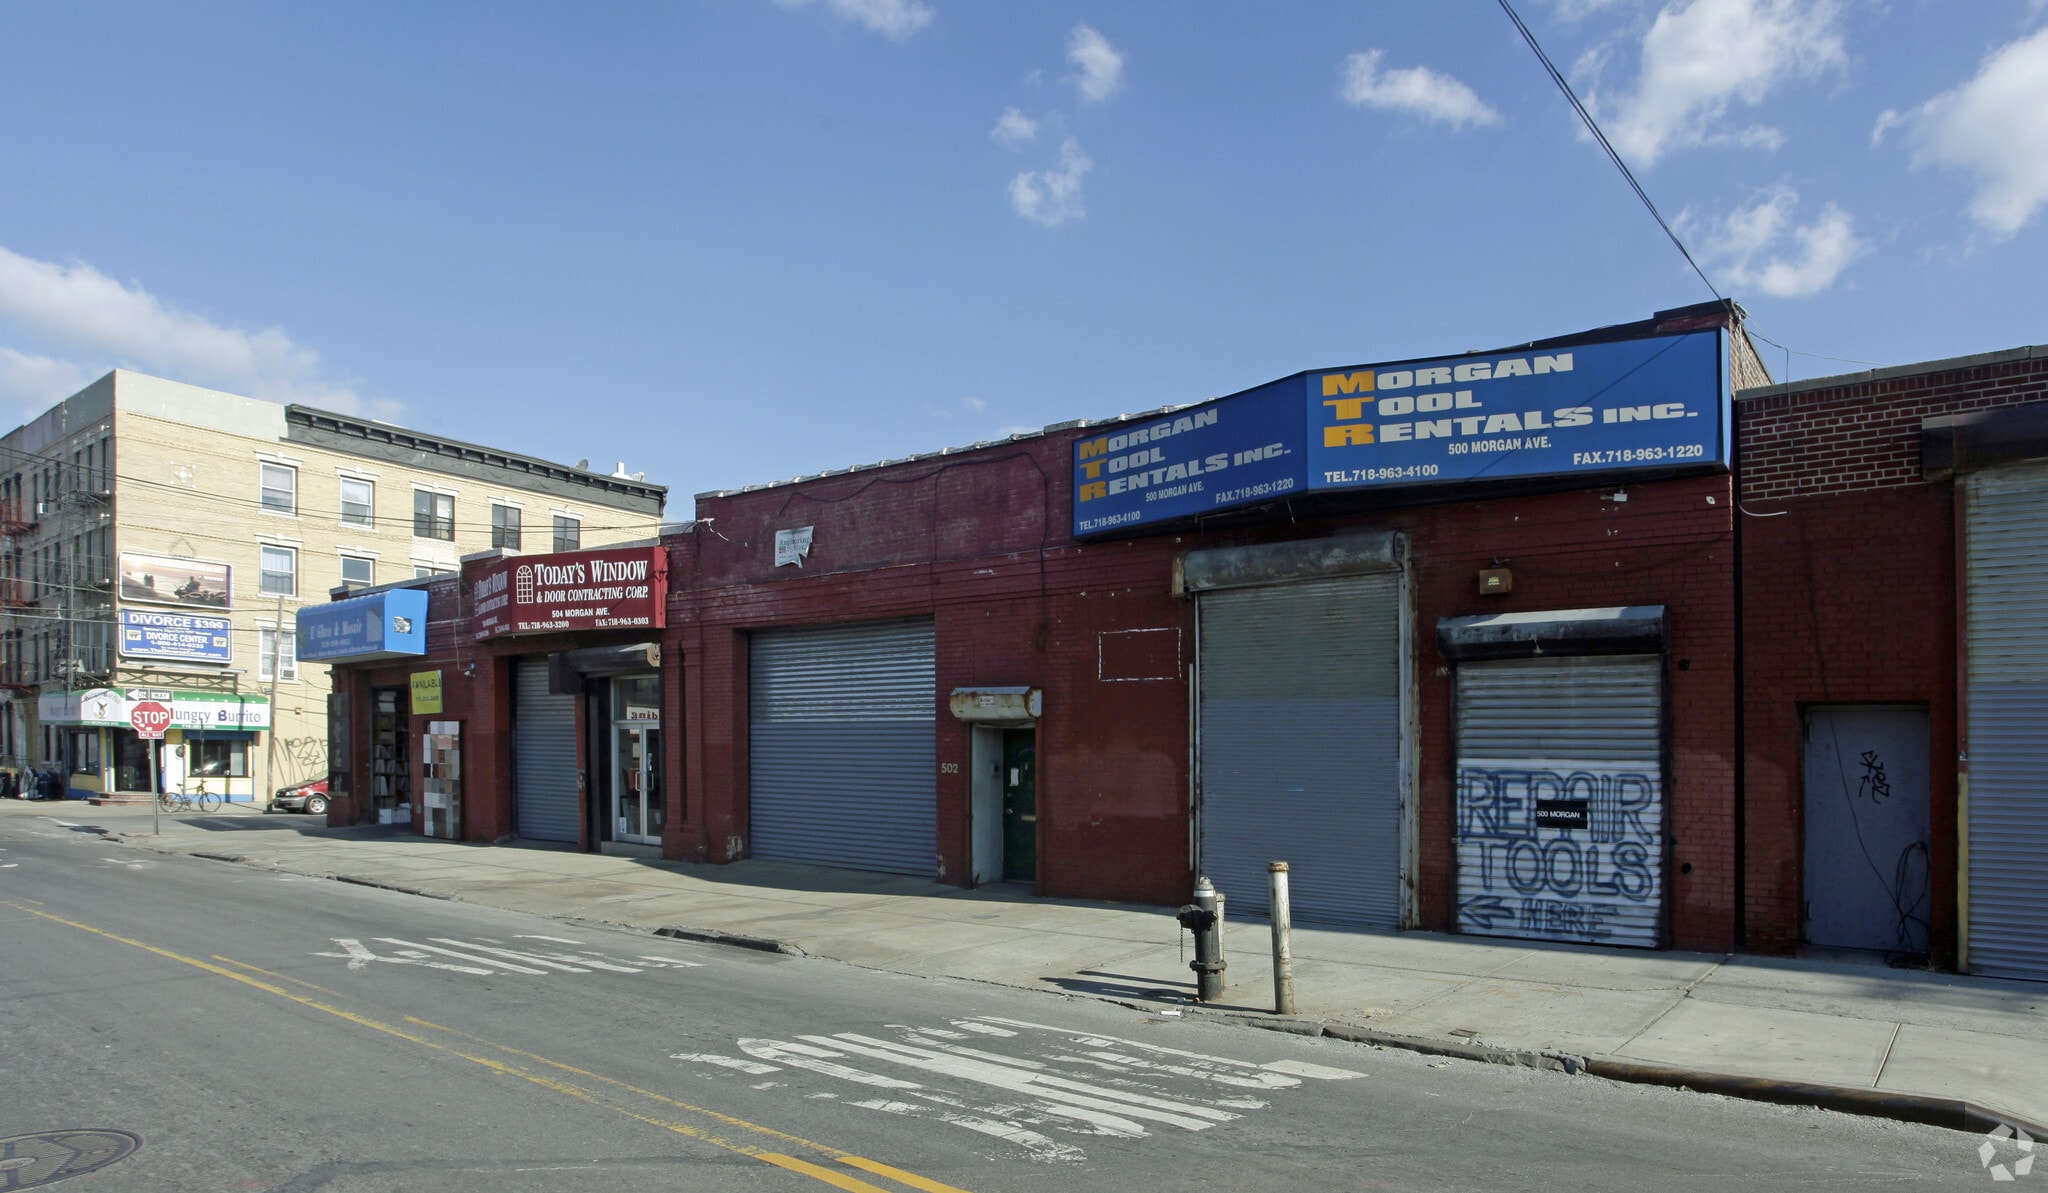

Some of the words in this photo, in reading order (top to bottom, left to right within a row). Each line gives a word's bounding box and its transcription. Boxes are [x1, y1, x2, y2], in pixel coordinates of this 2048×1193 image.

[1322, 353, 1573, 396] MORGAN
[1323, 390, 1482, 420] TOOL
[1079, 408, 1218, 460] MORGAN
[1324, 406, 1593, 448] RENTALS
[1603, 403, 1698, 424] INC.
[1448, 443, 1468, 455] 500
[1471, 438, 1521, 454] MORGAN
[1524, 436, 1552, 449] AVE.
[1573, 444, 1703, 465] FAX.718-963-1220
[1080, 447, 1166, 479] TOOL
[1080, 453, 1228, 502] RENTALS
[1233, 442, 1291, 467] INC.
[1324, 464, 1439, 483] TEL.718-963-4100
[1145, 491, 1158, 502] 500
[1158, 486, 1187, 500] MORGAN
[1188, 481, 1204, 494] AVE.
[1215, 477, 1294, 504] FAX.718-963-1220
[1079, 510, 1141, 530] TEL.718-963-4100
[534, 562, 585, 586] TODAY'S
[590, 560, 648, 583] WINDOW
[536, 591, 543, 603] &
[544, 591, 566, 603] DOOR
[567, 587, 623, 602] CONTRACTING
[625, 586, 648, 598] CORP.
[129, 614, 191, 628] DIVORCE
[194, 619, 224, 630] $399
[551, 609, 564, 618] 504
[565, 608, 593, 618] MORGAN
[595, 607, 610, 616] AVE.
[146, 632, 179, 642] DIVORCE
[179, 634, 208, 644] CENTER
[133, 711, 169, 724] STOP
[218, 709, 261, 723] Burrito
[941, 763, 959, 773] 502
[1537, 810, 1549, 818] 500
[1550, 811, 1580, 819] MORGAN
[1461, 838, 1653, 902] TOOLS
[1520, 898, 1619, 938] HERE
